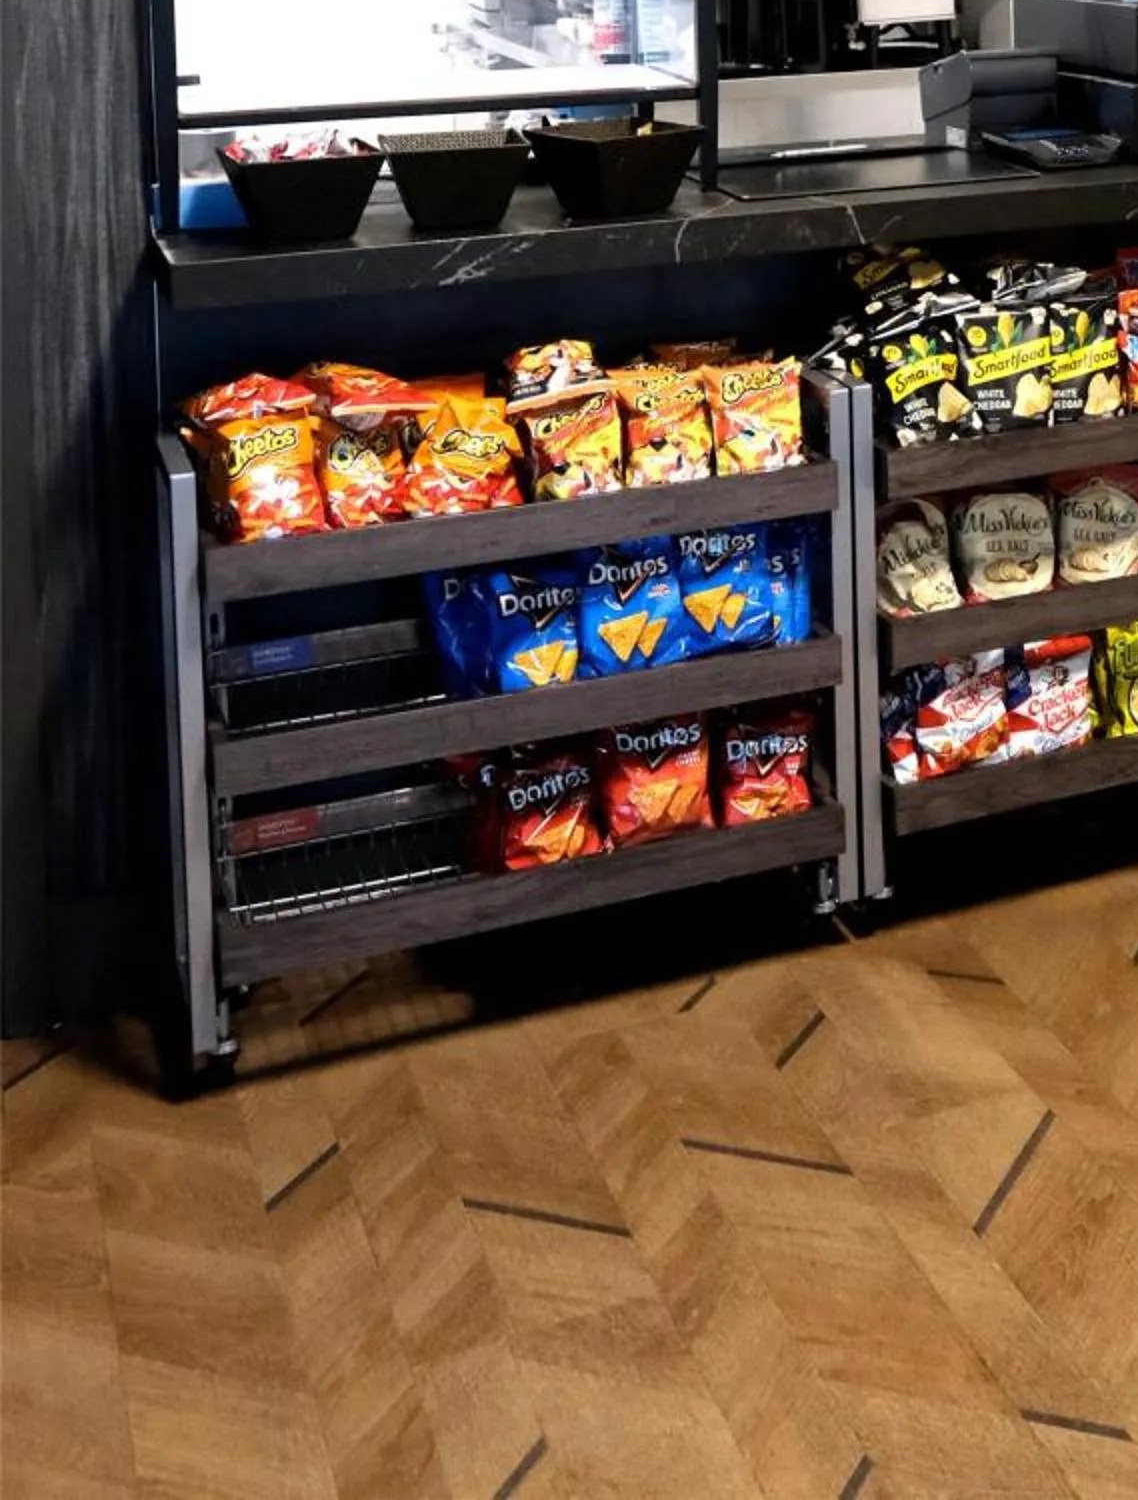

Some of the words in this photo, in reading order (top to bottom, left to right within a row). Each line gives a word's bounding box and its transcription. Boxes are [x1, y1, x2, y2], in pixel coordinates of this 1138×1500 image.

[973, 344, 1046, 380] Smartfood
[965, 512, 1001, 534] Miss
[679, 531, 756, 556] Doritos
[588, 555, 669, 586] Doritos
[615, 723, 701, 754] Doritos
[726, 735, 808, 761] Doritos
[508, 766, 590, 812] Doritos
